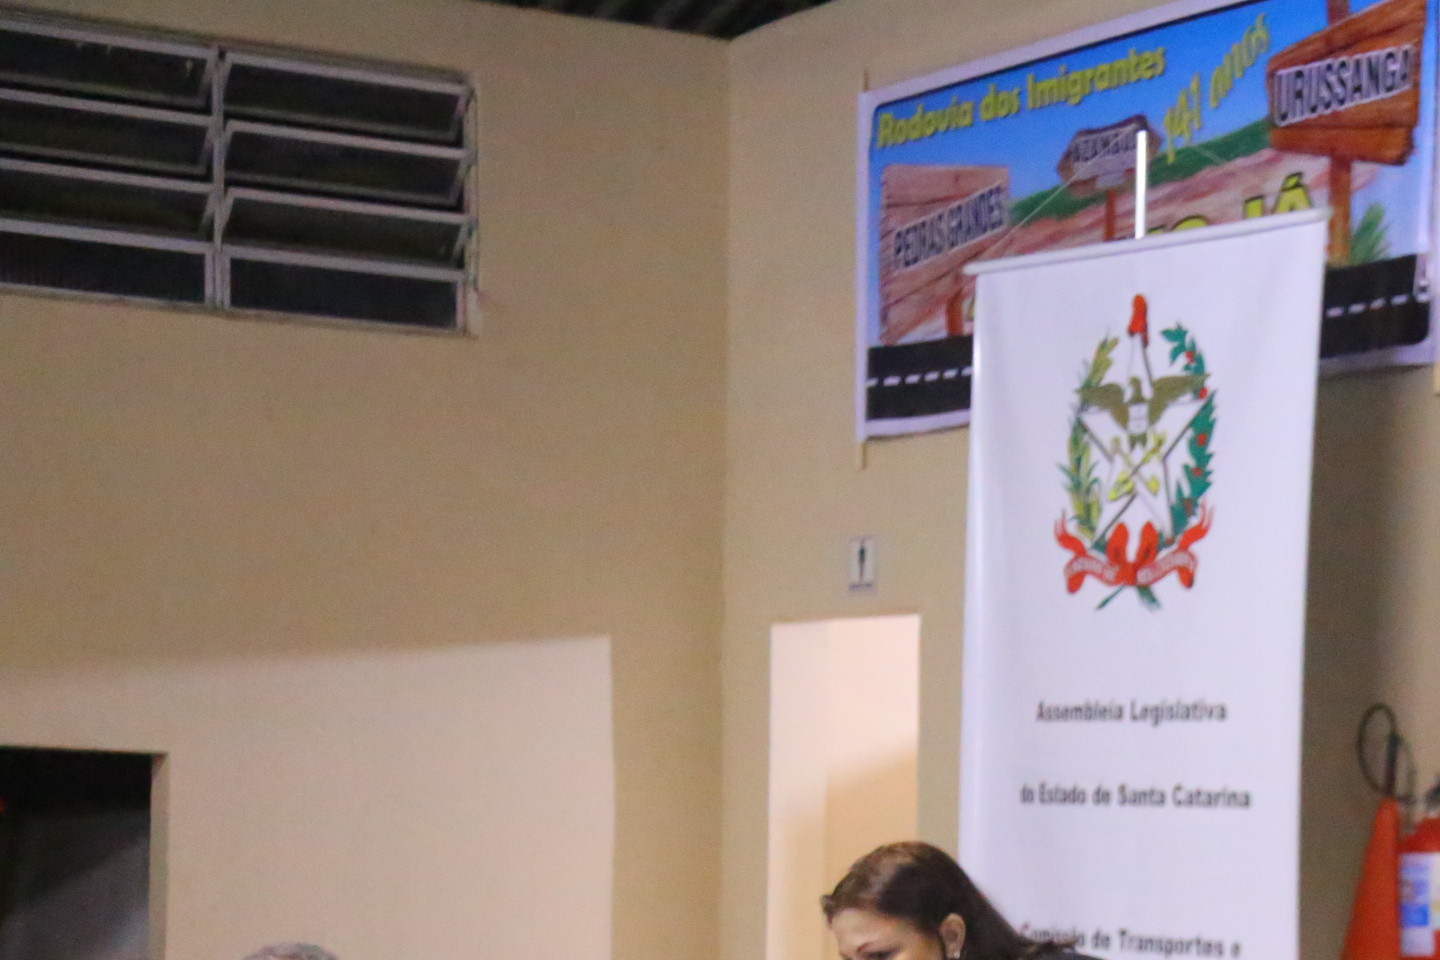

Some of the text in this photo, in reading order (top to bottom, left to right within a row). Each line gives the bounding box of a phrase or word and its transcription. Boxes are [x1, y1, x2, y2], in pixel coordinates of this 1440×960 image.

[877, 47, 1167, 148] Rodovia dos Imigrantes
[1277, 49, 1412, 121] URUSSANGA
[948, 184, 1004, 249] GRANDES
[1036, 700, 1227, 727] Assembleia Legislativa
[1020, 783, 1252, 809] do Estado de Santa Catarina
[1091, 928, 1111, 949] de
[1117, 928, 1225, 959] Transportes
[1230, 941, 1242, 959] e
